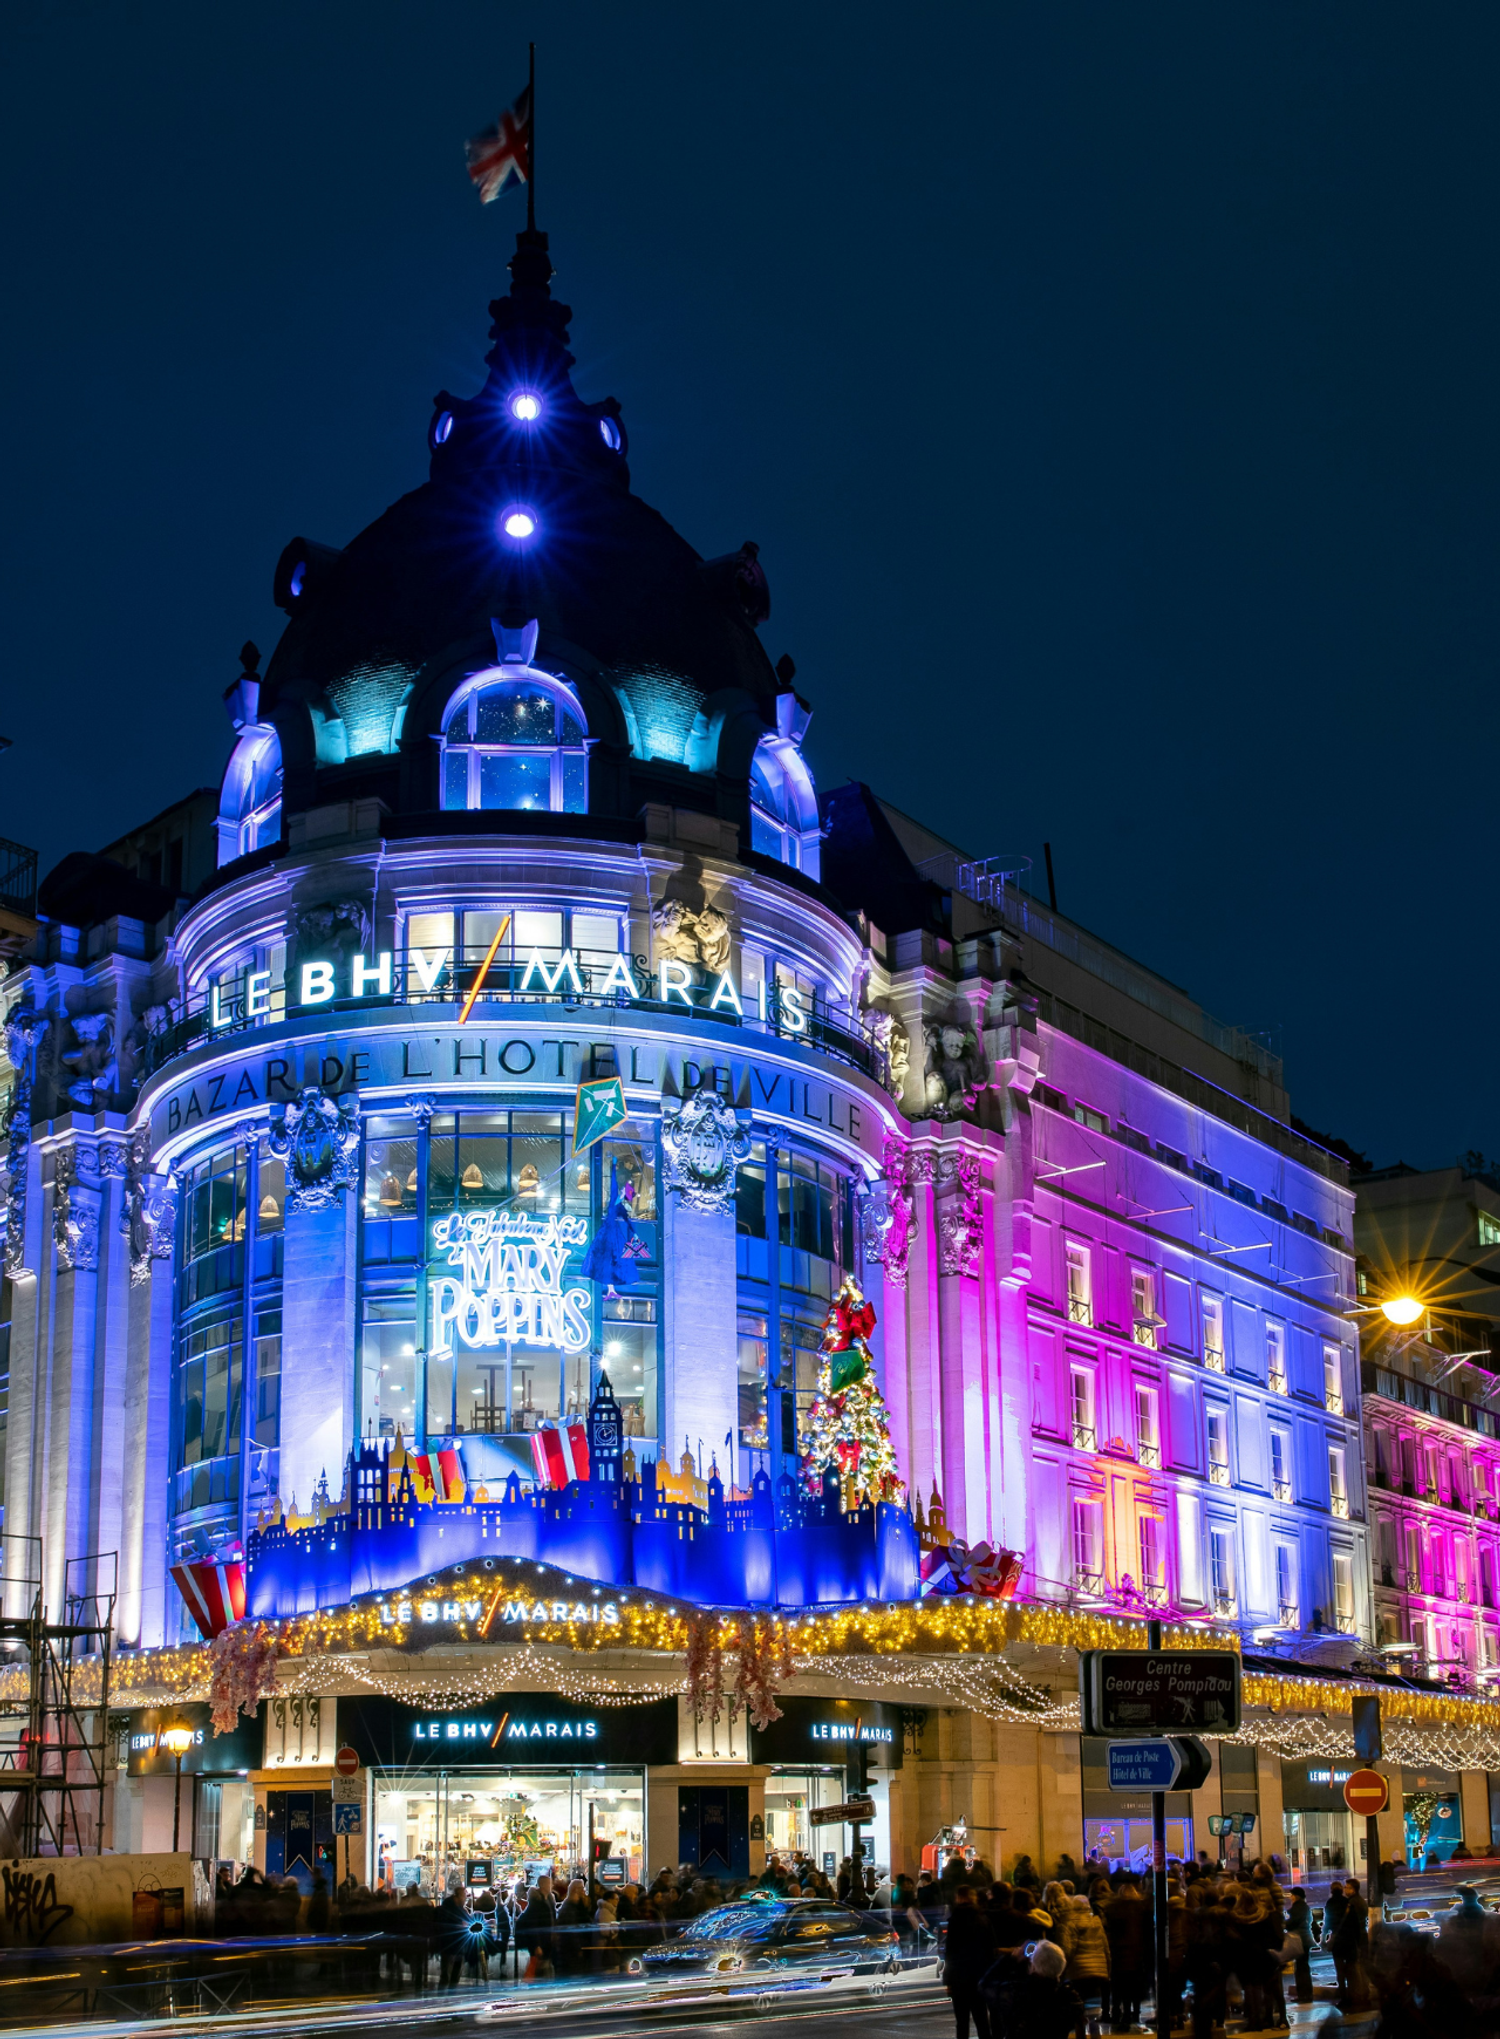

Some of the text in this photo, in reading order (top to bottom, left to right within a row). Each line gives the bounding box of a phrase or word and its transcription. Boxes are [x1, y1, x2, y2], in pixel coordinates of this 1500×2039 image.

[211, 947, 806, 1032] LE BHV MARAIS
[167, 1037, 861, 1141] BAZAR DE L'HOTEL DE VILLE
[432, 1213, 466, 1249] Le
[461, 1238, 572, 1295] MARY
[429, 1277, 591, 1360] POPPINS
[382, 1600, 619, 1624] LE BHV MARAIS
[1146, 1660, 1192, 1675] Centre
[1105, 1676, 1232, 1695] Georges Pompidou
[415, 1722, 597, 1738] LE BHV MARAIS
[812, 1724, 892, 1742] LE BHV MARAIS
[1112, 1750, 1160, 1764] Bureau de Poste
[1112, 1767, 1152, 1780] Hôtel de Ville
